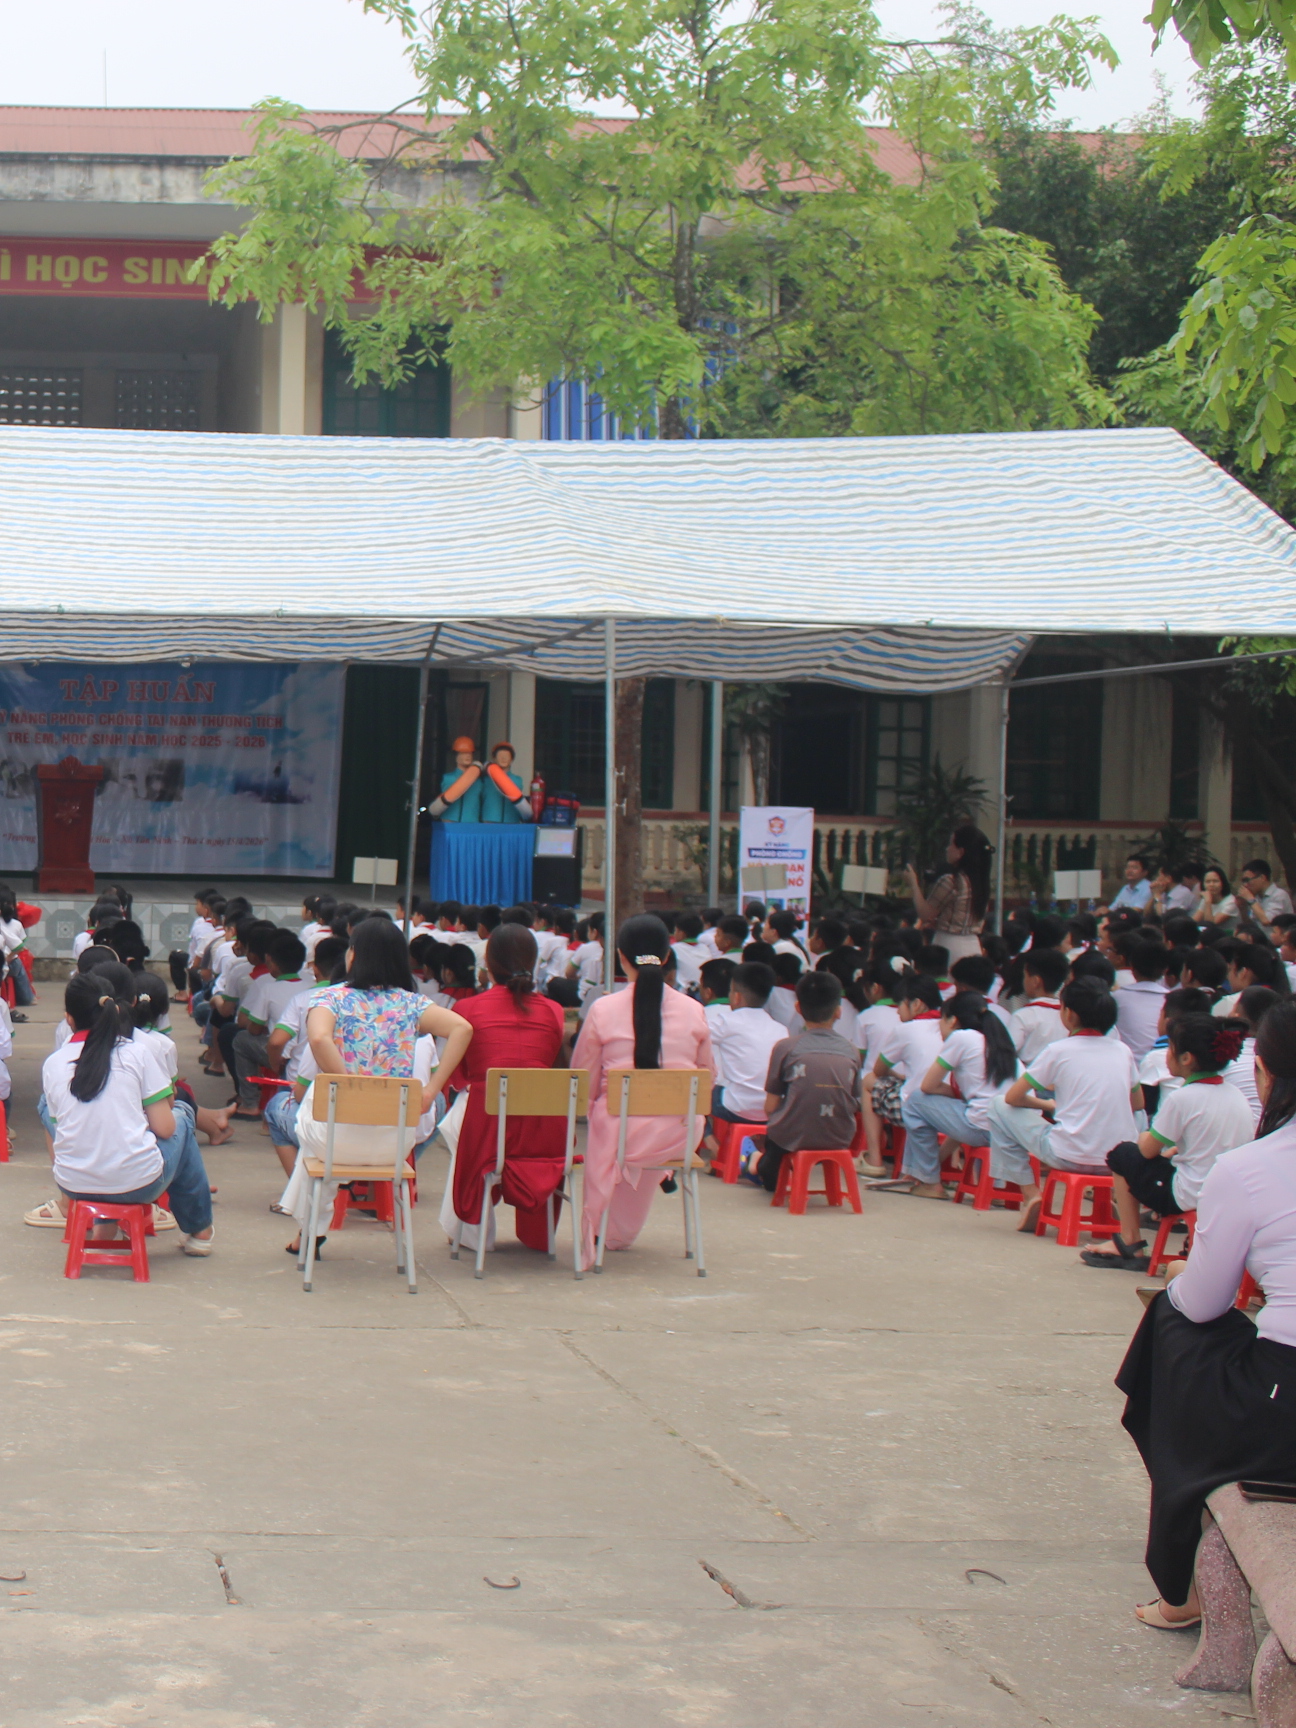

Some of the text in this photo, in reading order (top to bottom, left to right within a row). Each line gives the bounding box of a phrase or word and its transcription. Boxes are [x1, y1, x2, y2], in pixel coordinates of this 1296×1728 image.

[26, 254, 109, 288] HỌC
[122, 257, 215, 286] SINH
[60, 673, 217, 707] TẬP HUẤN
[10, 709, 47, 725] NĂNG
[50, 710, 95, 726] PHÒNG
[98, 710, 143, 727] CHỐNG
[147, 714, 166, 727] TAI
[34, 732, 58, 745] EM,
[61, 733, 88, 747] HỌC
[92, 734, 123, 746] SINH
[127, 731, 158, 746] NĂM
[161, 734, 187, 748] HỌC
[191, 735, 222, 748] 2025
[235, 736, 266, 748] 2026
[788, 875, 804, 886] NỔ
